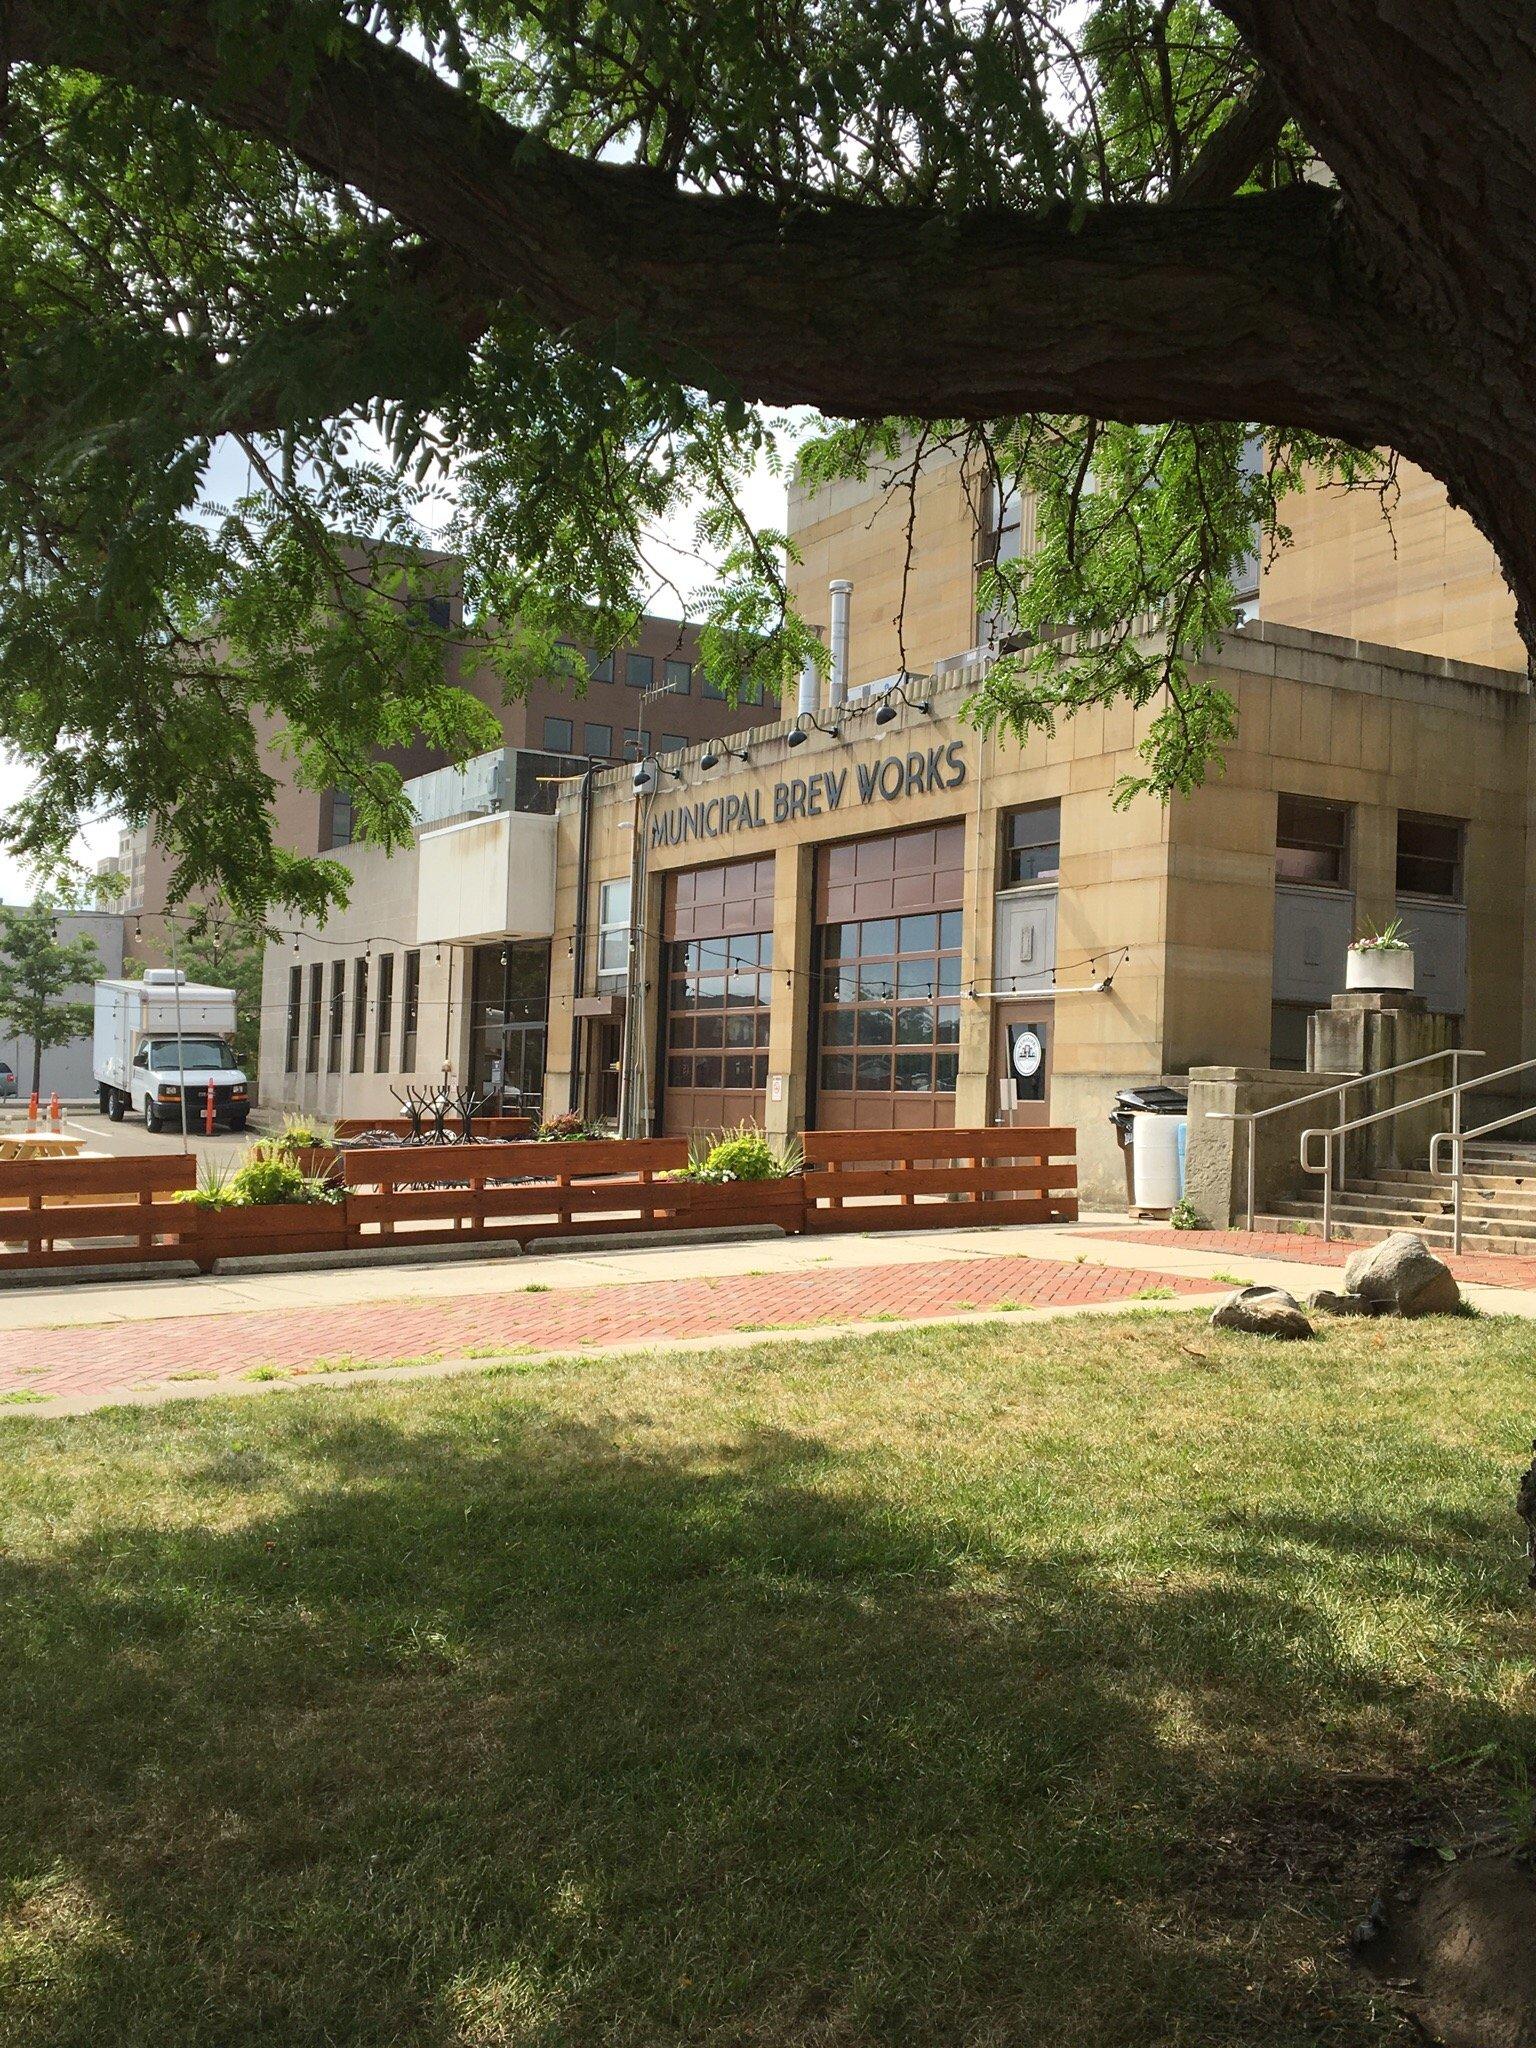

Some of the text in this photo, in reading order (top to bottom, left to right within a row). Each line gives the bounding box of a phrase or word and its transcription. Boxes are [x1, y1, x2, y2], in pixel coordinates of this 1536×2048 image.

[652, 740, 966, 849] MUNICIPAL BREW WORKS
